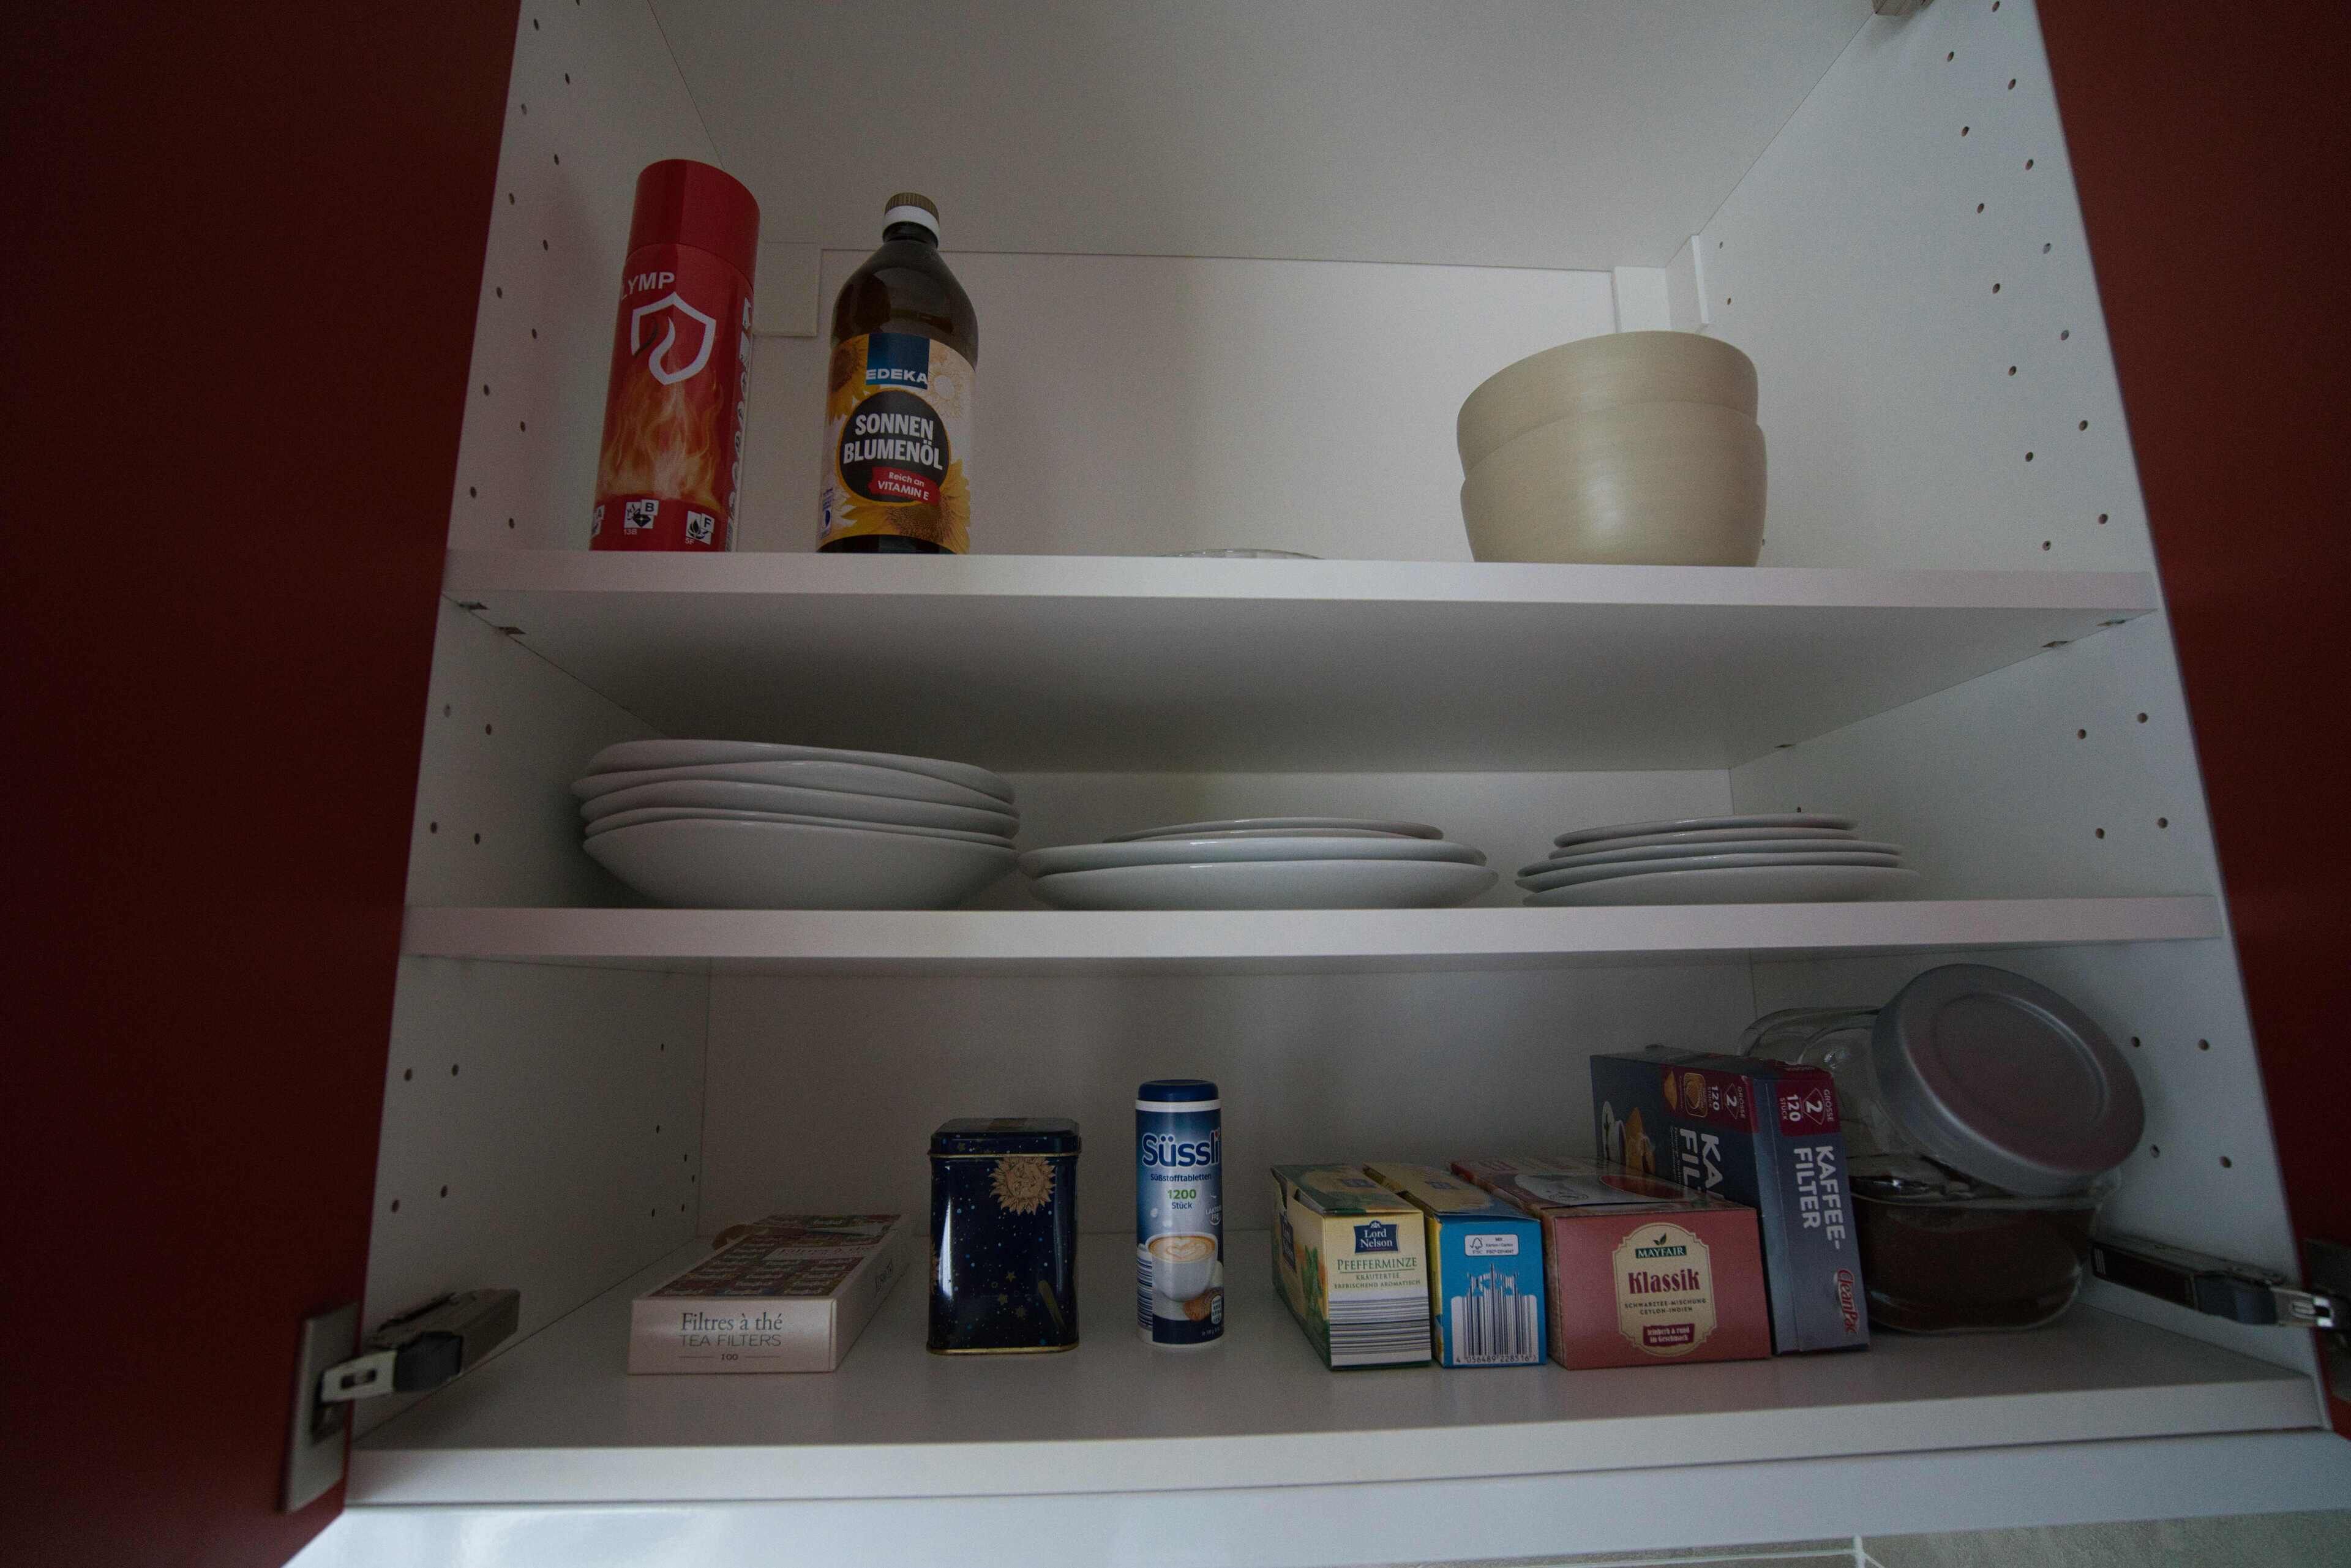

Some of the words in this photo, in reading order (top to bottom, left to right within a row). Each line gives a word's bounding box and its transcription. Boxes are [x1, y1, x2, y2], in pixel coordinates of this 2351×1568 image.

[621, 271, 675, 301] YMP
[865, 369, 928, 383] EDEKA
[855, 413, 934, 440] SONNEN
[843, 438, 943, 470] BLUMENÖL
[889, 471, 912, 483] Reich
[877, 481, 921, 498] VITAMIN
[923, 490, 929, 500] E
[646, 503, 654, 512] B
[704, 517, 711, 527] F
[1712, 1085, 1720, 1111] 120
[1726, 1095, 1738, 1108] 2
[1787, 1094, 1801, 1122] 120
[1806, 1100, 1823, 1113] 2
[1679, 1128, 1701, 1191] FIL
[1168, 1189, 1196, 1199] 1200
[1793, 1147, 1821, 1229] FILTER
[1815, 1146, 1846, 1250] KAFFEE-
[1364, 1229, 1387, 1239] Lord
[1360, 1237, 1393, 1249] Nelson
[1638, 1247, 1686, 1258] MAYFAIR
[1337, 1257, 1418, 1270] PFEFFERMINZE
[1628, 1269, 1700, 1294] Klassik
[682, 1312, 733, 1330] Filtres
[740, 1313, 749, 1330] à
[756, 1312, 782, 1330] thé
[678, 1335, 711, 1346] TEA
[718, 1334, 782, 1346] FILTERS
